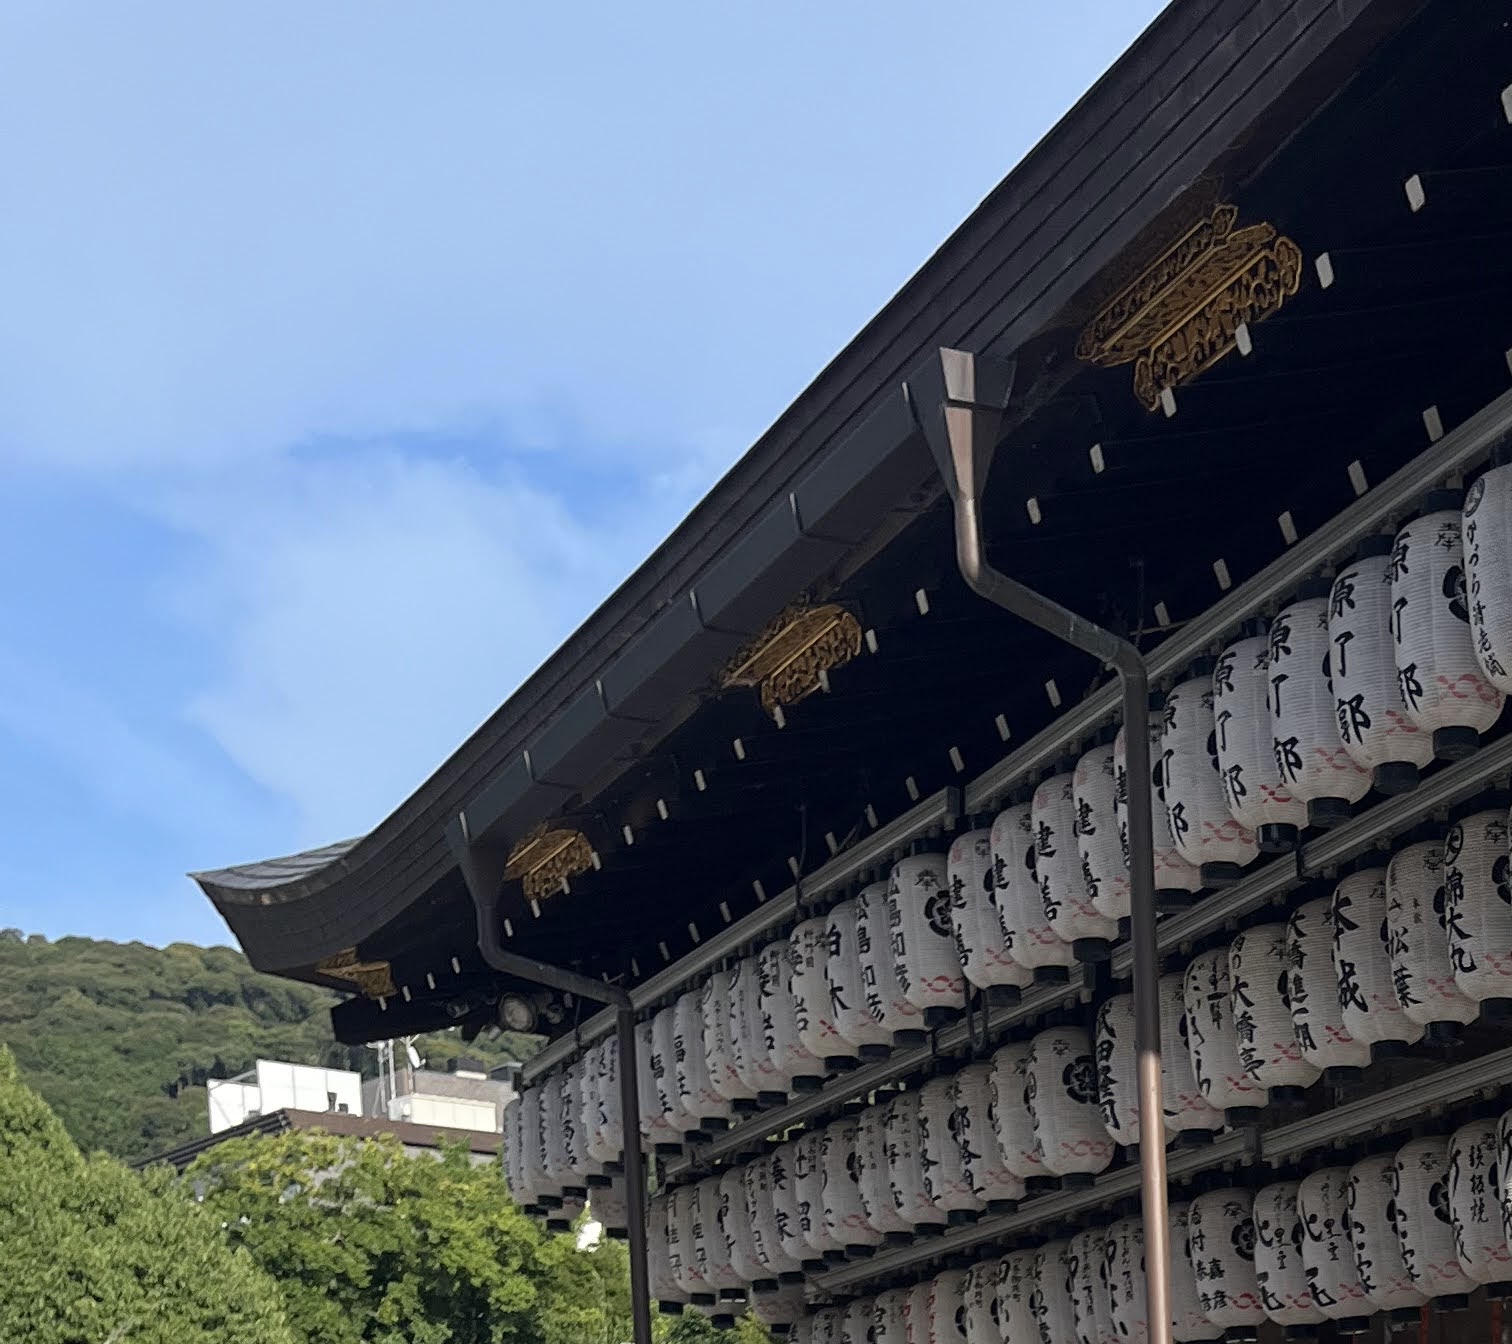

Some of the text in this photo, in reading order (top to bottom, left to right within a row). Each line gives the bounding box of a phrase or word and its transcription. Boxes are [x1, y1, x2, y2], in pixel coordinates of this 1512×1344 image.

[1268, 614, 1303, 784] 原了郭
[1330, 572, 1371, 745] 原了郭
[1392, 532, 1422, 714] 原了郭
[1214, 651, 1247, 808] 原了郭
